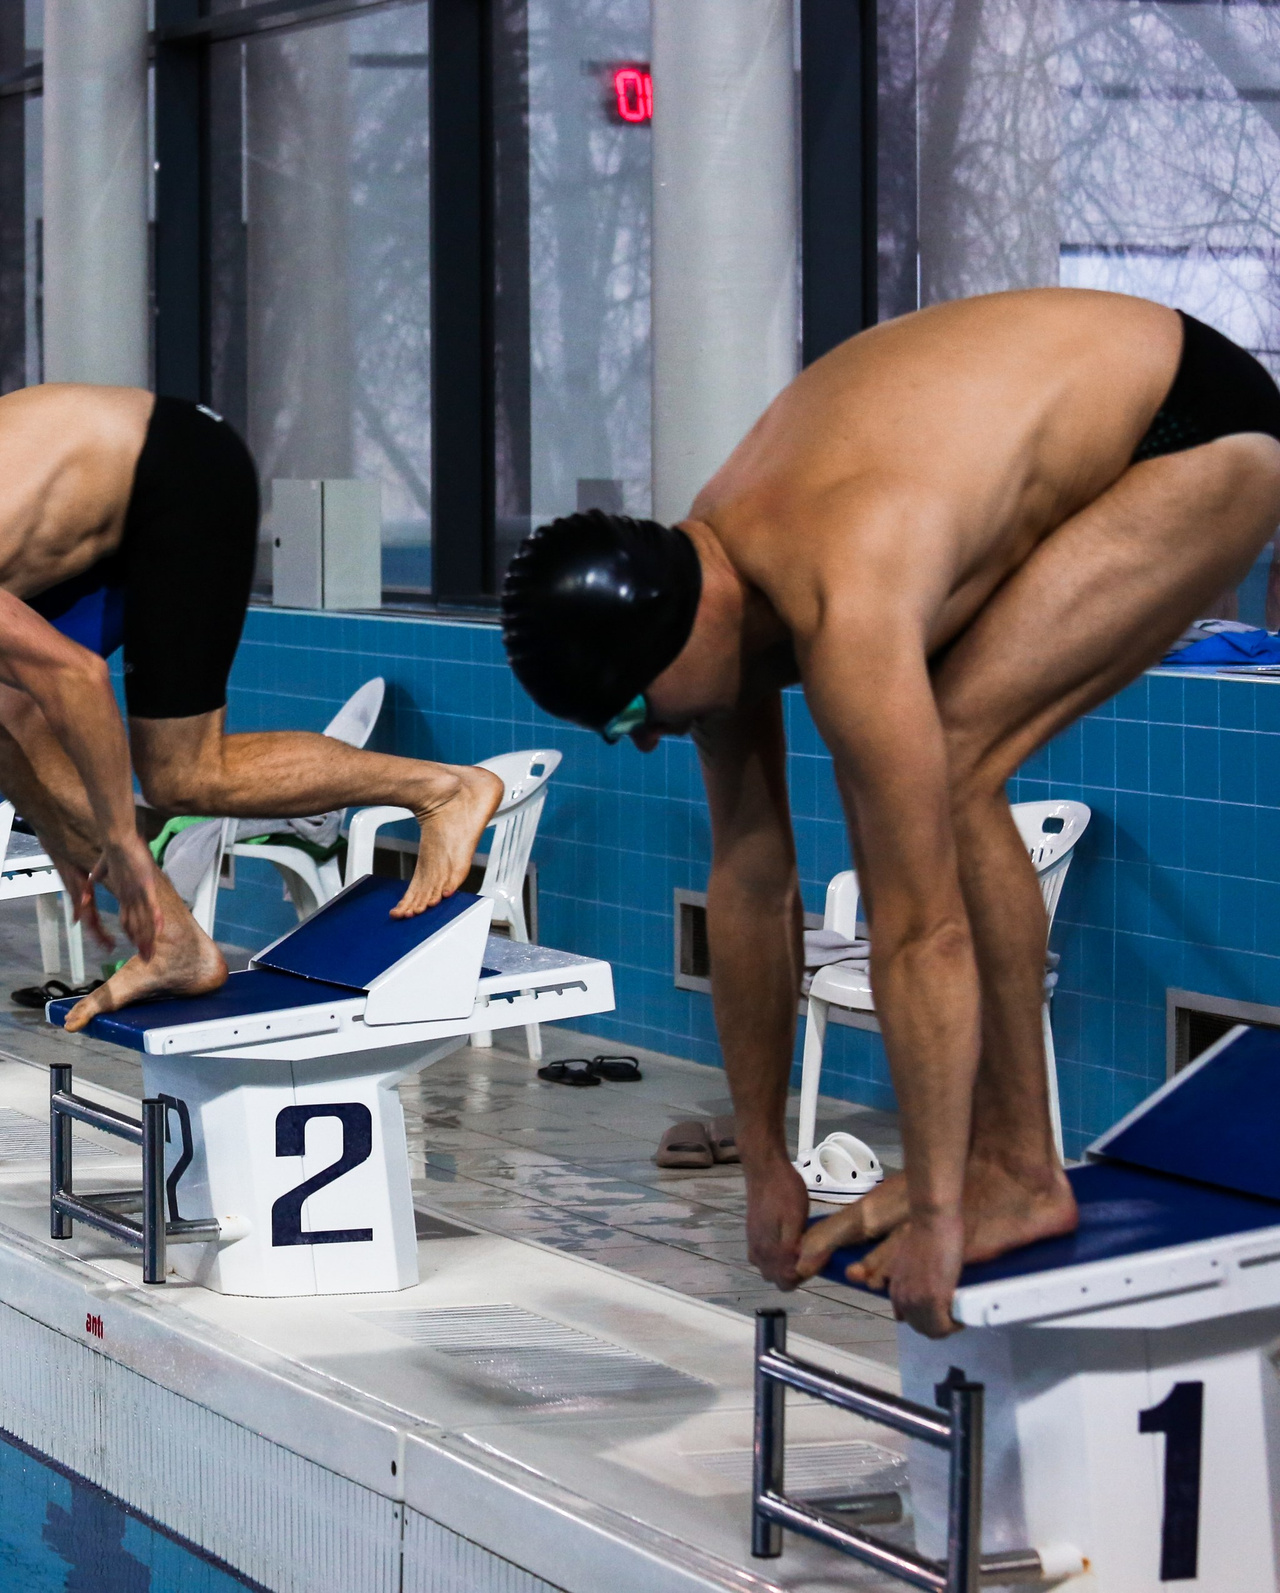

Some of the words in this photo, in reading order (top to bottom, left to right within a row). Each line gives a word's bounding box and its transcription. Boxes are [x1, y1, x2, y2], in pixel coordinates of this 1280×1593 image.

[614, 68, 653, 122] 0
[271, 1102, 374, 1248] 2
[86, 1312, 104, 1339] anti
[1138, 1381, 1204, 1581] 1
